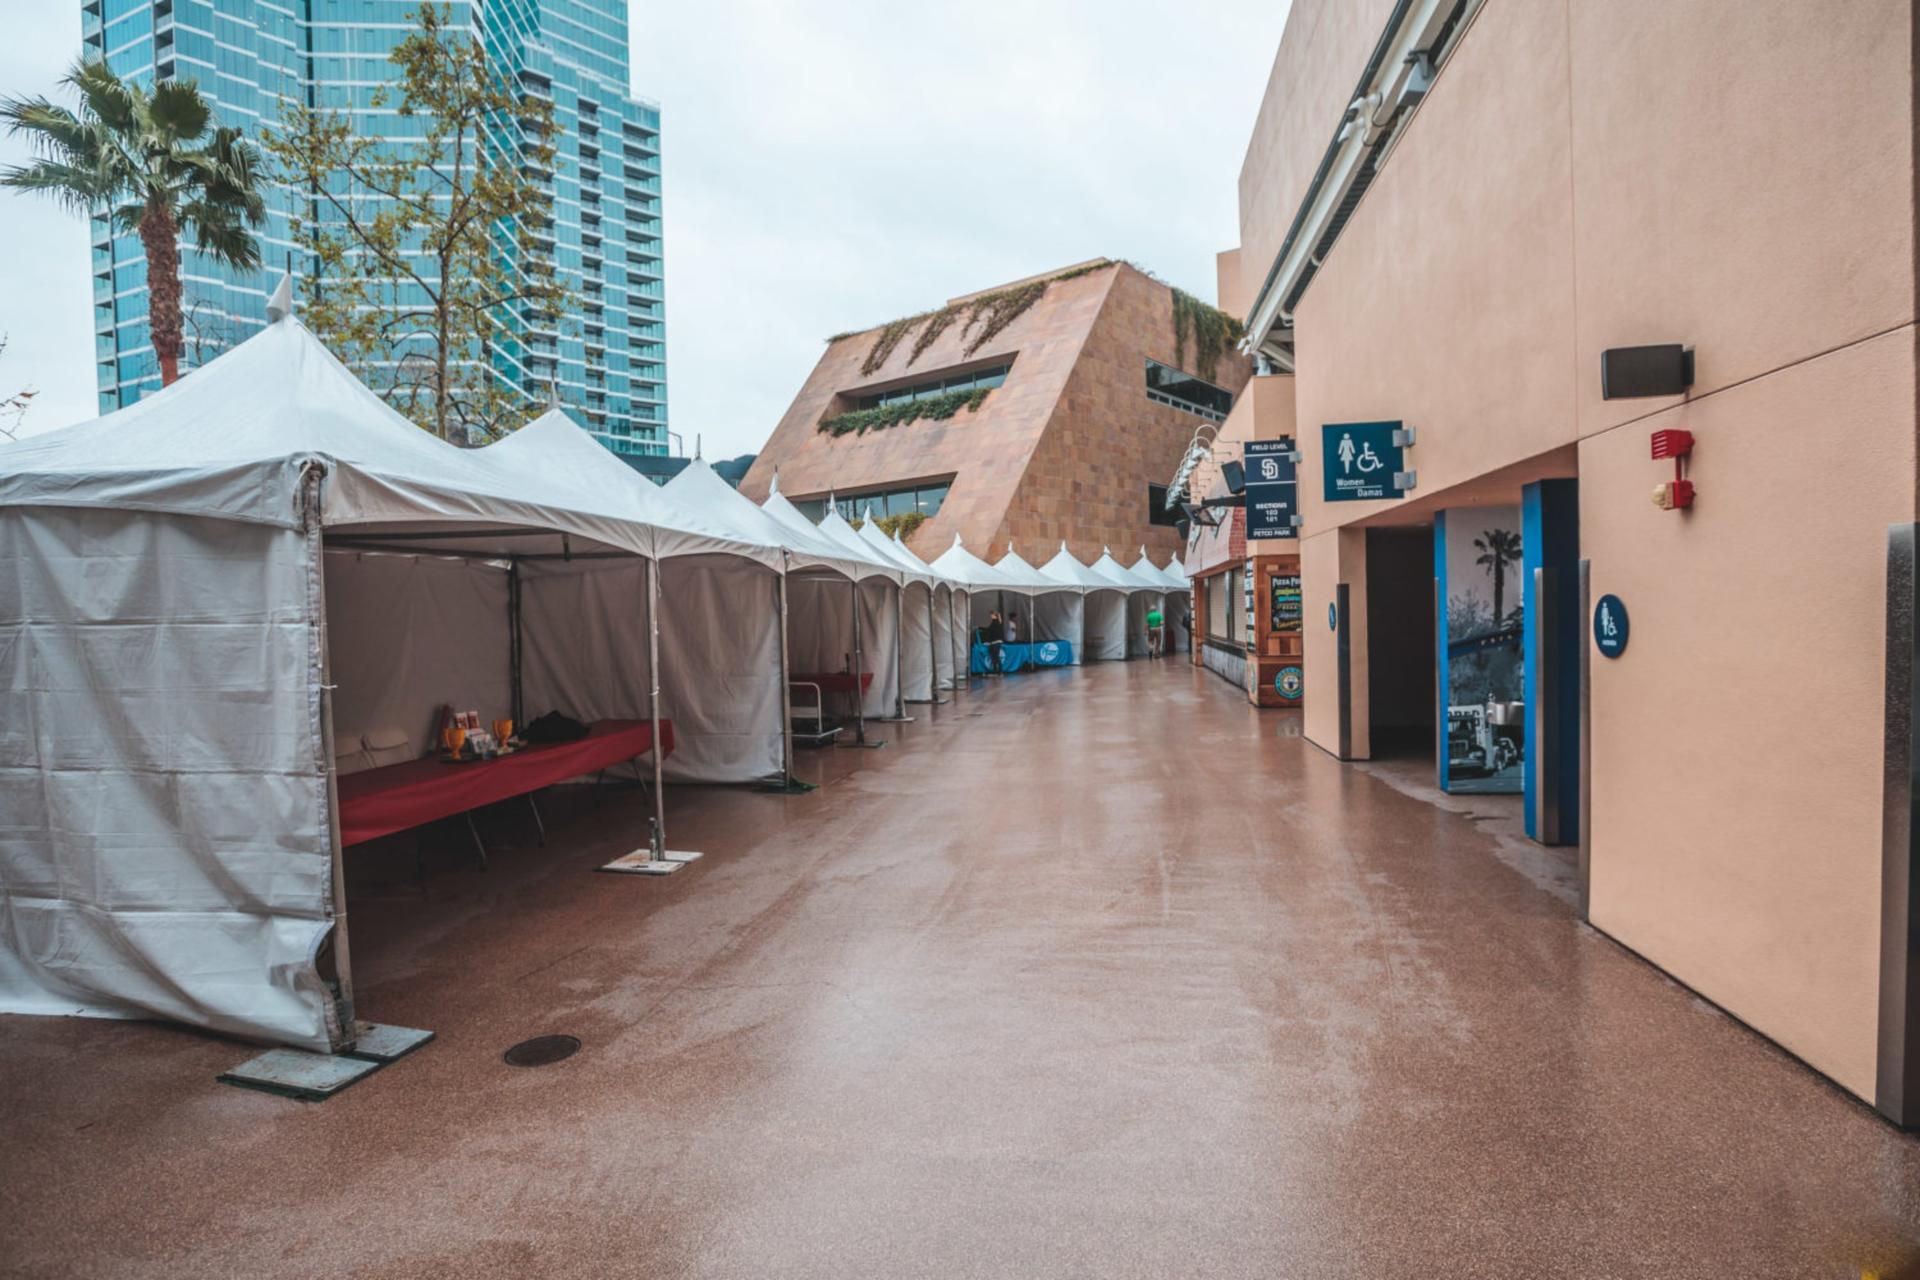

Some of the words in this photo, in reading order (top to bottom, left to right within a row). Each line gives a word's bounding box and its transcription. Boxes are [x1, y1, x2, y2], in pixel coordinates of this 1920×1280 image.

[1261, 458, 1279, 480] SD
[1336, 478, 1365, 486] Women
[1357, 488, 1383, 497] Damas
[1255, 502, 1287, 510] SECTIONS
